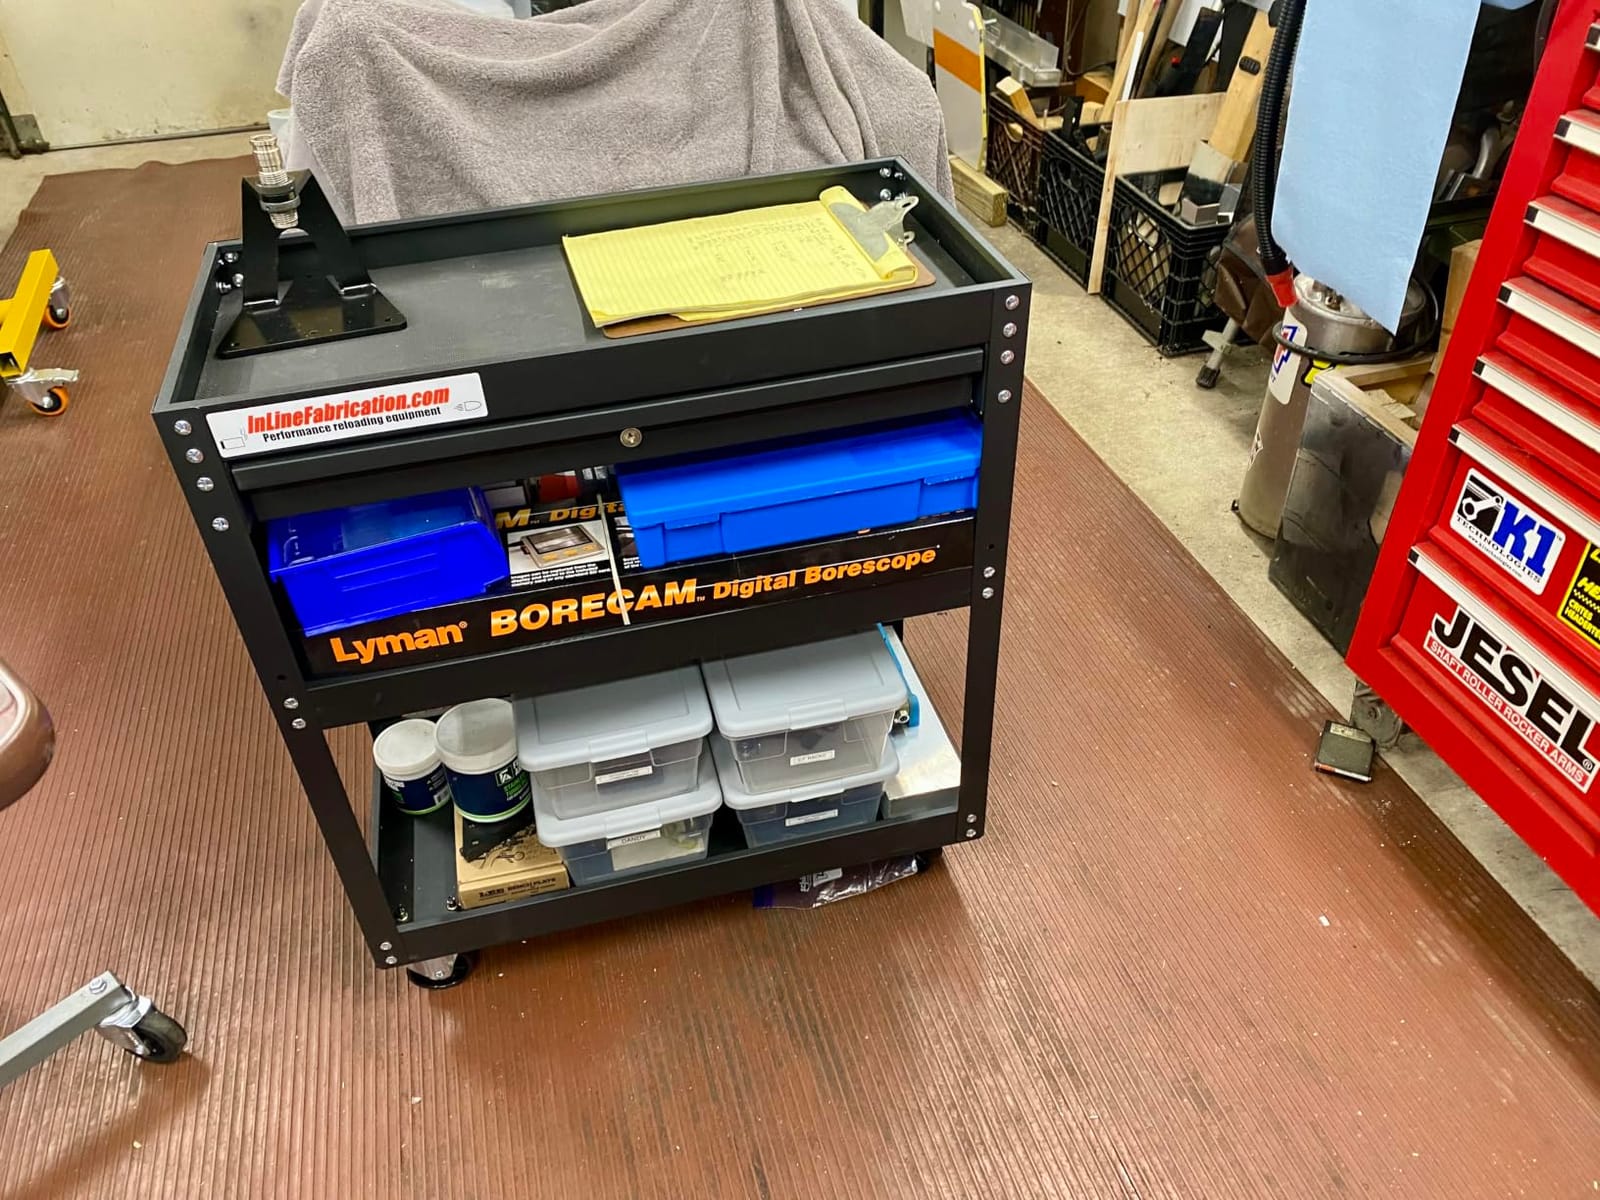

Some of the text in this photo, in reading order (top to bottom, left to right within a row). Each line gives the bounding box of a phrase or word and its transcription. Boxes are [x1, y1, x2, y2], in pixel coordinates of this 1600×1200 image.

[247, 386, 450, 434] InLineFabrication.com
[263, 406, 442, 443] Performance reloading equipment
[1456, 514, 1541, 584] TECHNOLOGIES
[1492, 501, 1556, 577] K1
[713, 571, 796, 600] Digital
[804, 548, 937, 585] Borescope
[1431, 640, 1584, 782] SHAFT ROLLER ROCKER ARMS
